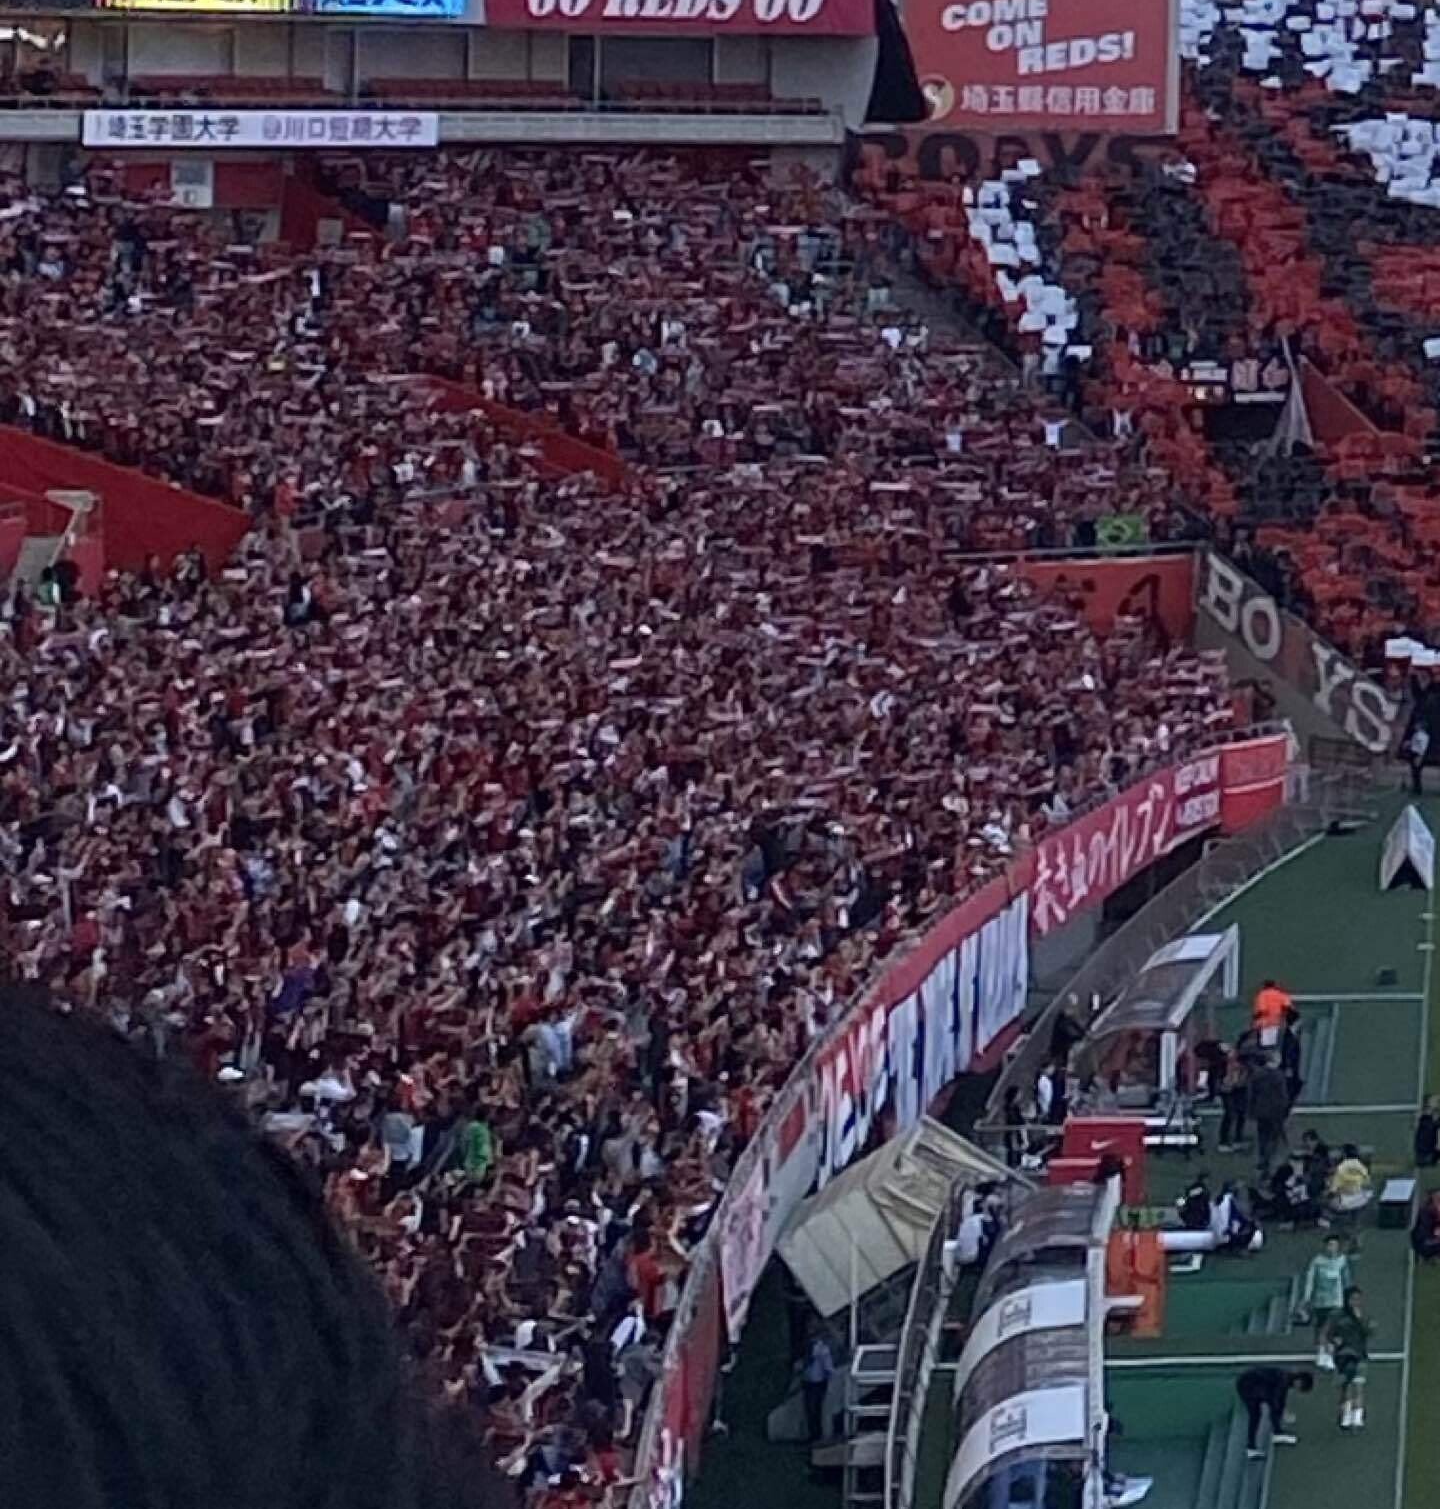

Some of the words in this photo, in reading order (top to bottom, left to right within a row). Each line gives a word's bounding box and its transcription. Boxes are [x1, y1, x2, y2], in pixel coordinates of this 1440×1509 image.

[986, 20, 1043, 51] ON
[1017, 31, 1135, 75] REDS!
[1200, 552, 1398, 752] BOYS
